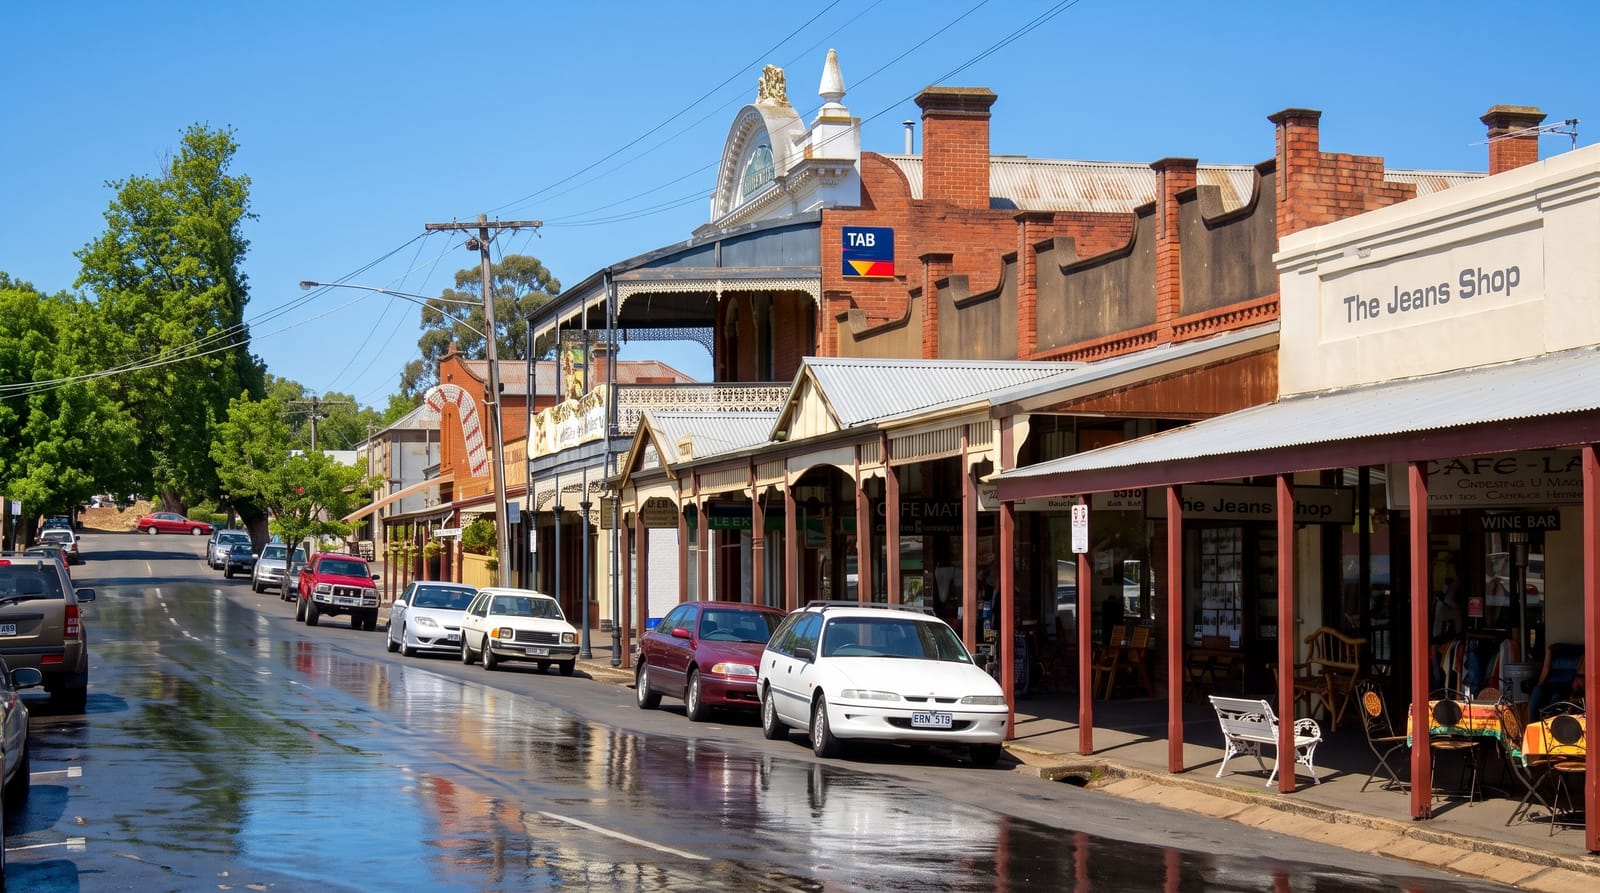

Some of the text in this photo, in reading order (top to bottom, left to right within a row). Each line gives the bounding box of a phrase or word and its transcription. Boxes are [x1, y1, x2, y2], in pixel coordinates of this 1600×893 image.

[847, 232, 876, 247] TAB
[1343, 265, 1520, 323] The Jeans Shop
[876, 502, 920, 518] CFE
[1181, 497, 1332, 518] he Jeans hop
[1480, 514, 1557, 529] WINE BAR
[913, 714, 931, 724] ERN
